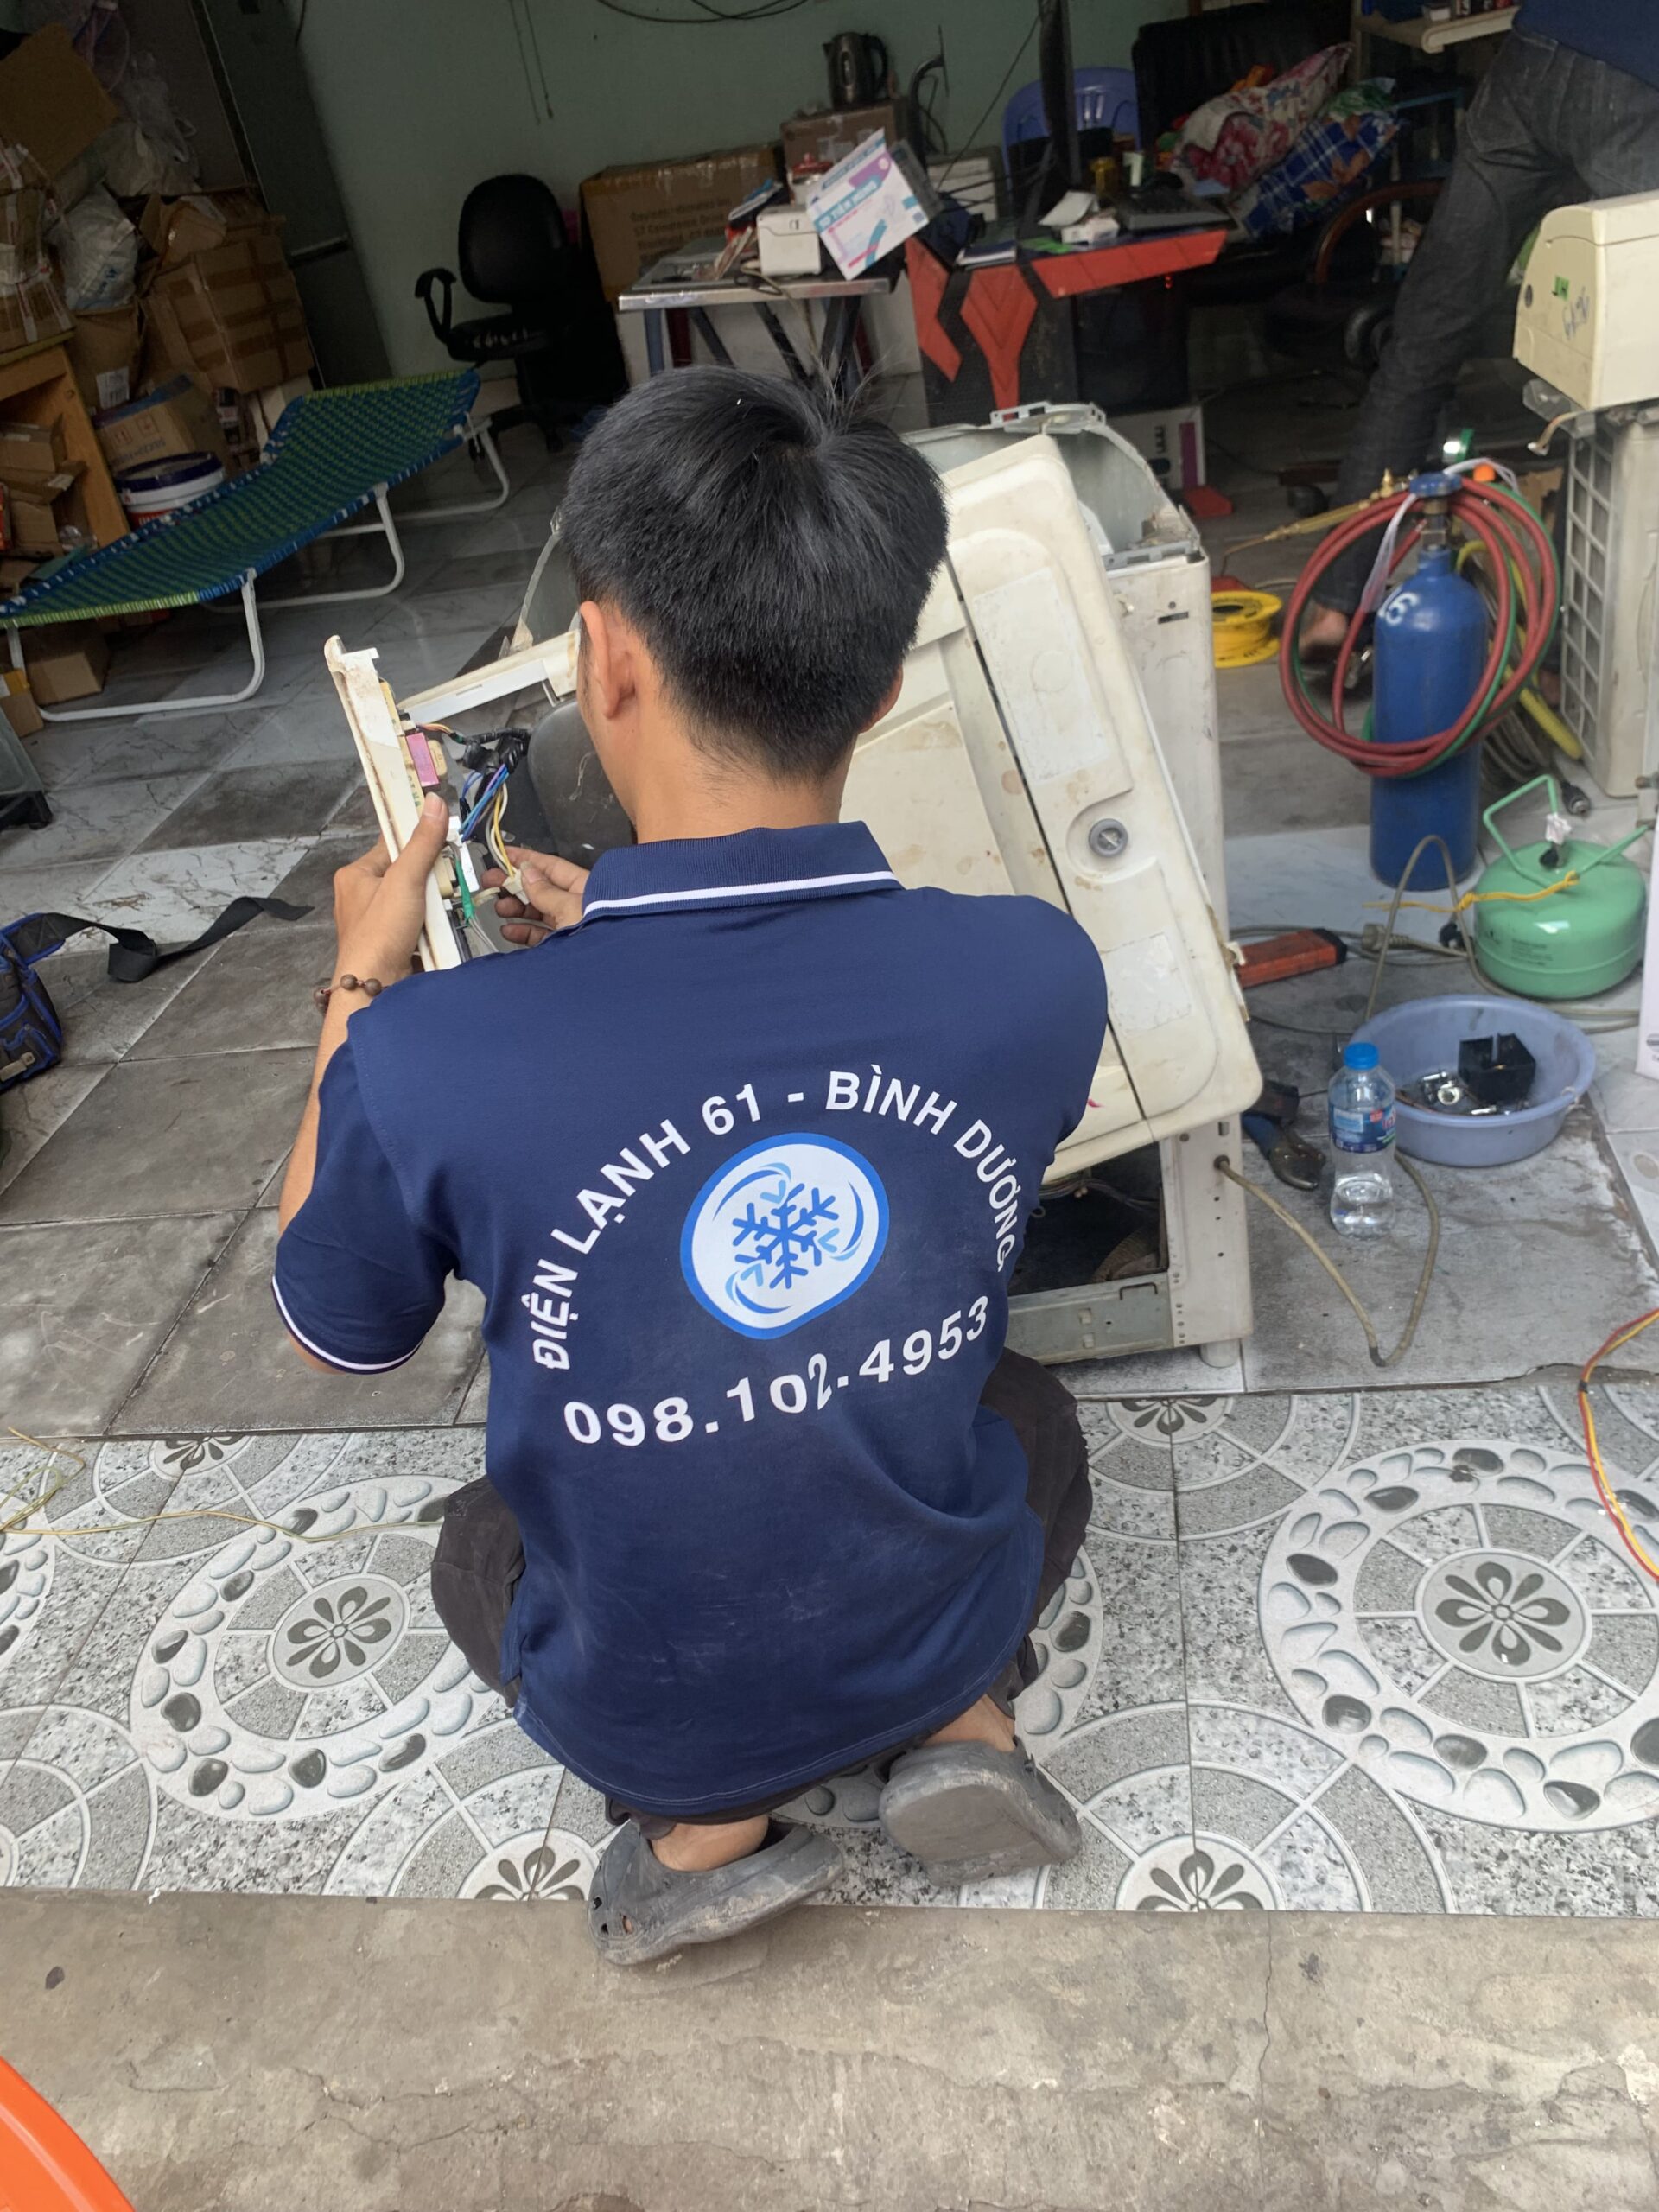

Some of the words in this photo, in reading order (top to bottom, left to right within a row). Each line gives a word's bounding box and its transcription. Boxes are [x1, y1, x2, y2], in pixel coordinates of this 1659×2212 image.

[521, 1258, 579, 1370] ĐIỆN
[550, 1119, 692, 1255] LẠNH
[702, 1084, 761, 1135] 61
[825, 1064, 957, 1135] BÌNH
[953, 1119, 1021, 1273] DƯƠNG
[563, 1295, 989, 1446] 098.102.4953
